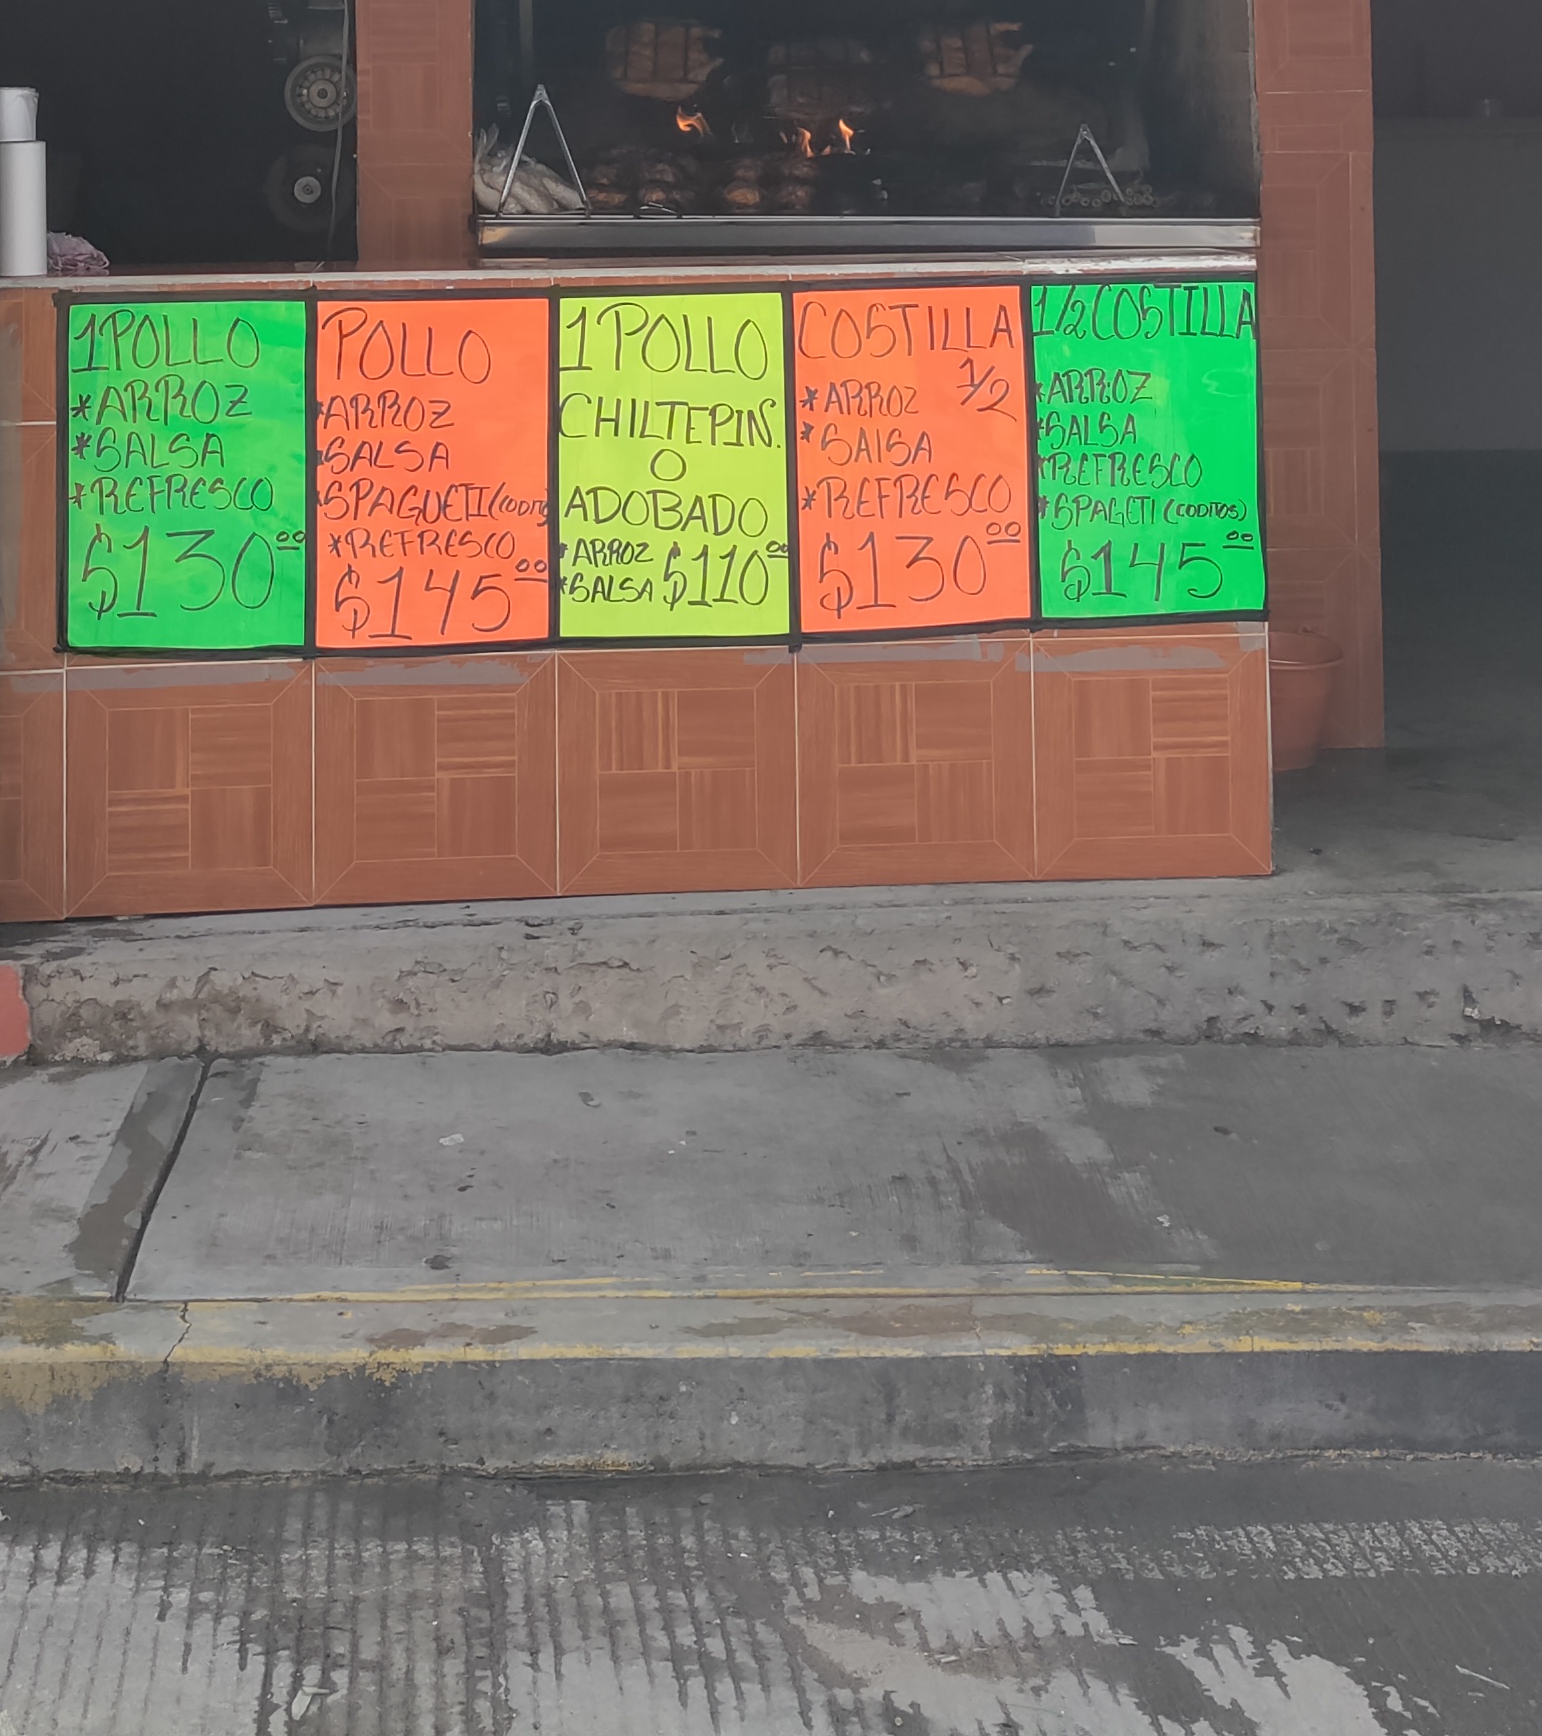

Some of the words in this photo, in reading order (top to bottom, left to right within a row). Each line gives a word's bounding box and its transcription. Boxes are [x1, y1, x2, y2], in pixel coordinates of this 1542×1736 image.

[71, 312, 109, 373] 1
[98, 308, 260, 372] POLLO
[798, 301, 1015, 359] COSTILLA
[1032, 283, 1087, 341] 1/2
[1091, 282, 1257, 341] COSTILLA
[322, 307, 491, 385] POLLO
[558, 306, 593, 371] 1
[596, 302, 768, 381] POLLO
[322, 389, 455, 432] ARROZ
[956, 357, 1018, 422] 1/2
[322, 435, 450, 475] SALSA
[650, 448, 687, 482] O
[564, 486, 768, 537] ADOBADO
